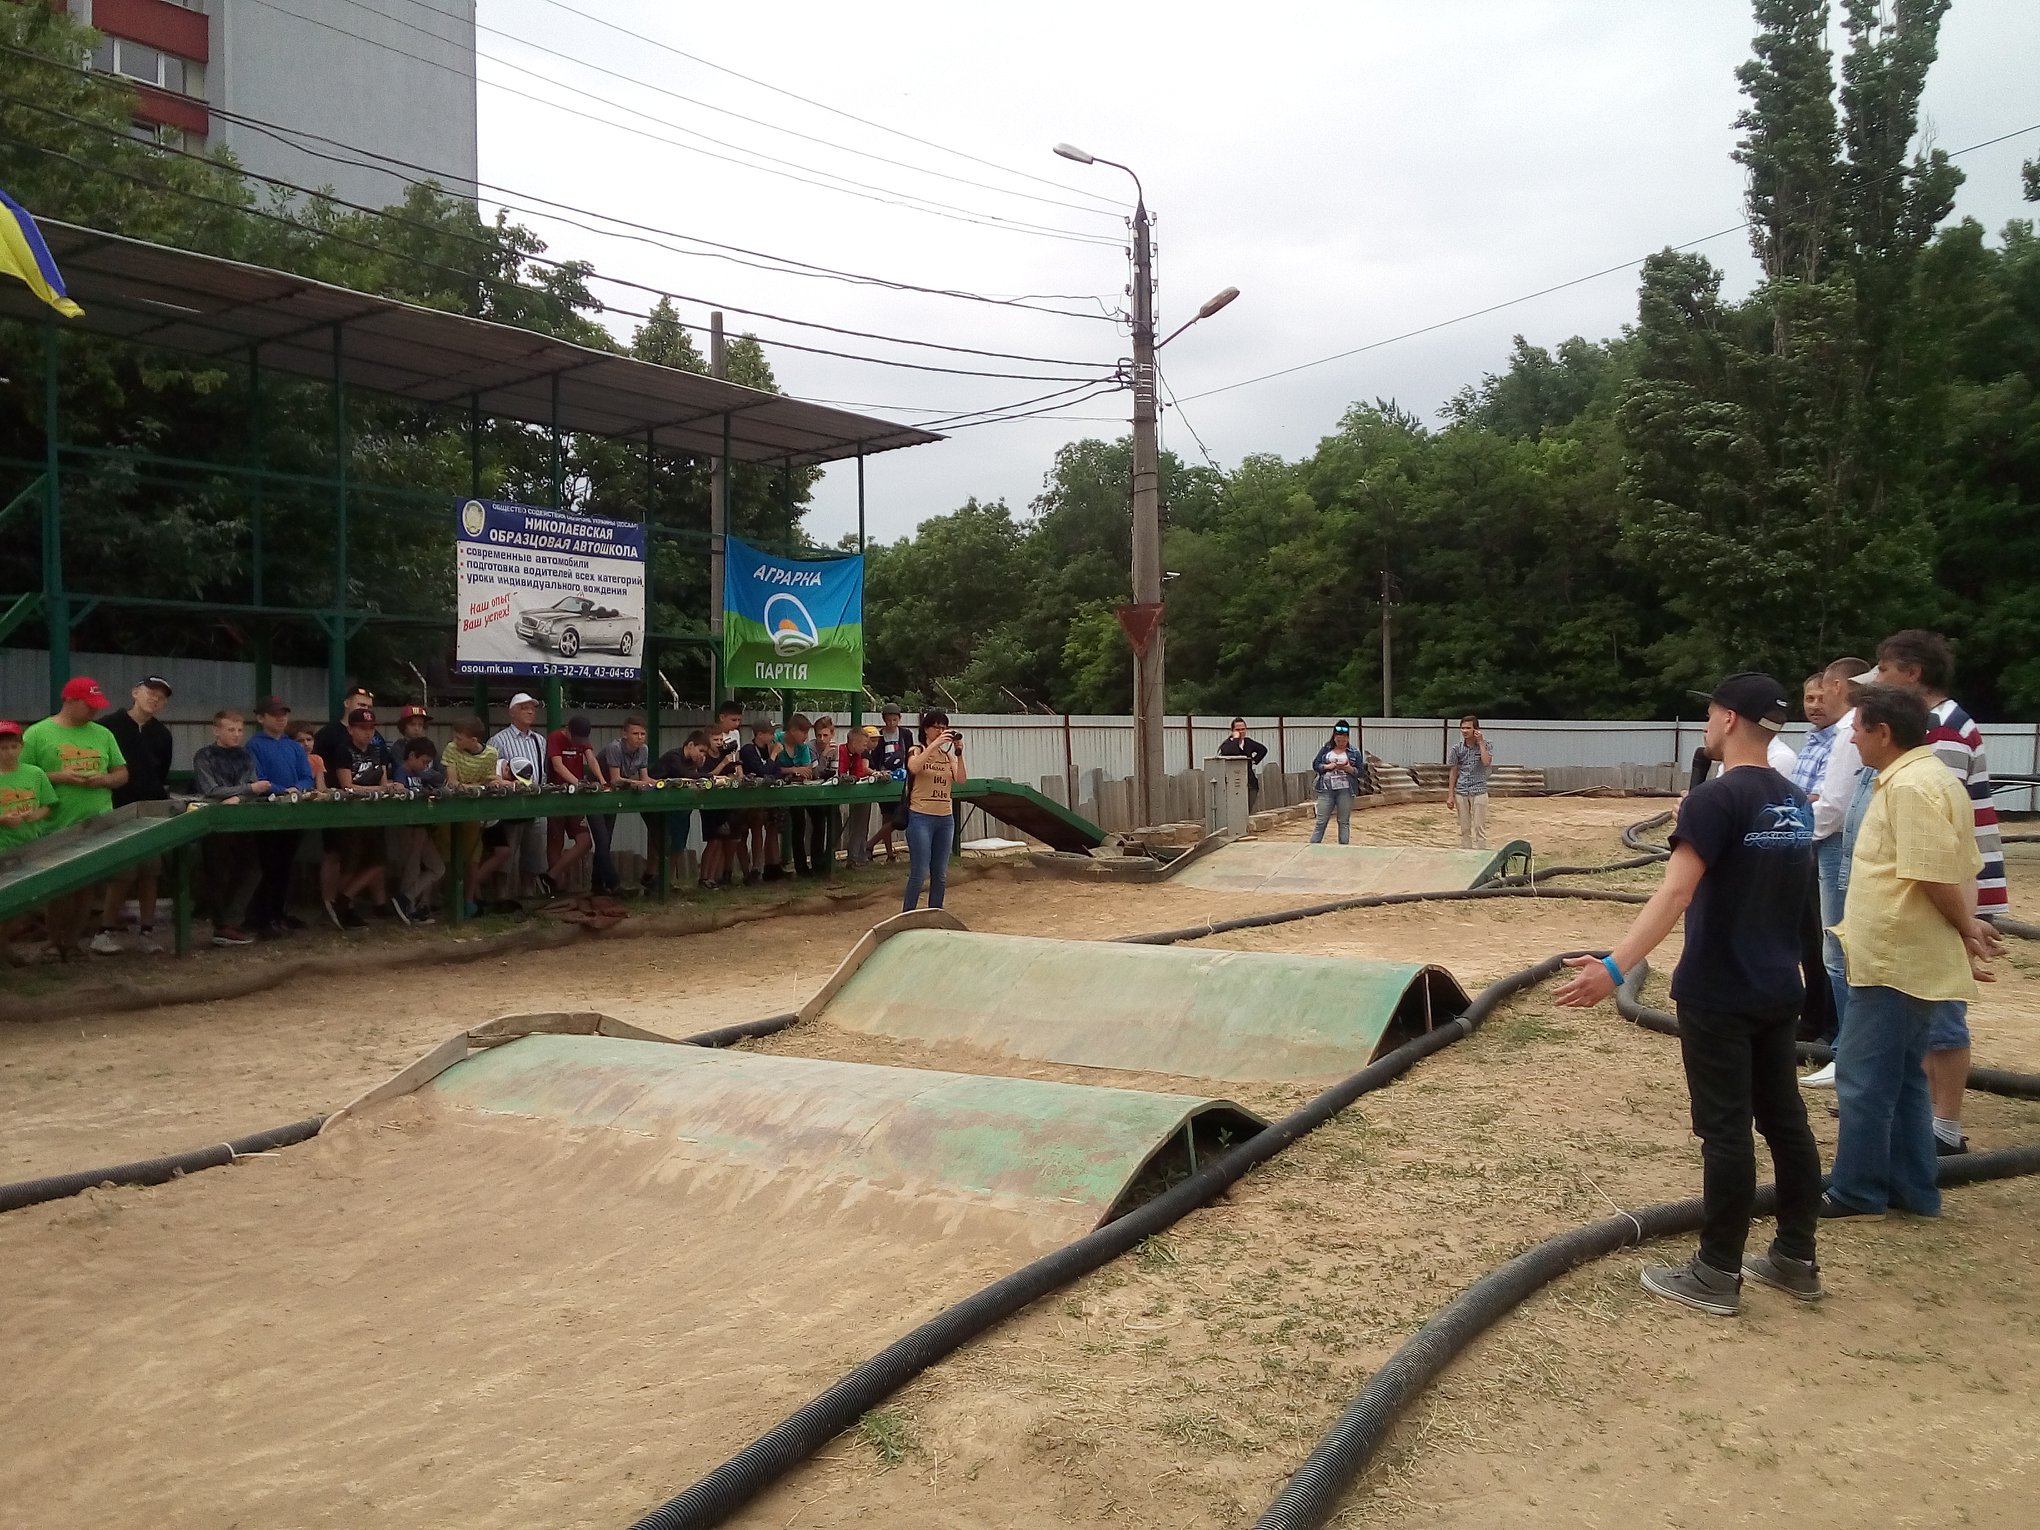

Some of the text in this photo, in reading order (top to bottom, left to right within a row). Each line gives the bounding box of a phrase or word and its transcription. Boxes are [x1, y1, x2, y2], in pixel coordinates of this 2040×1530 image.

[525, 517, 613, 540] НИКОЛАЕВСКАЯ
[489, 529, 638, 558] ОБРАЗЦОВАЯ АВТОШКОЛА
[466, 547, 589, 569] современные автомобили
[466, 560, 643, 587] подготовка водителей всех категорий
[466, 573, 627, 596] уроки индивидуального вождения
[753, 564, 822, 586] АГРАРНА
[470, 602, 489, 615] Наш
[491, 593, 511, 608] опыт
[463, 604, 510, 632] Ваш успех!
[461, 662, 513, 674] osou.mk.ua
[594, 667, 634, 678] 43-04-65
[755, 661, 808, 680] ПАРТІЯ
